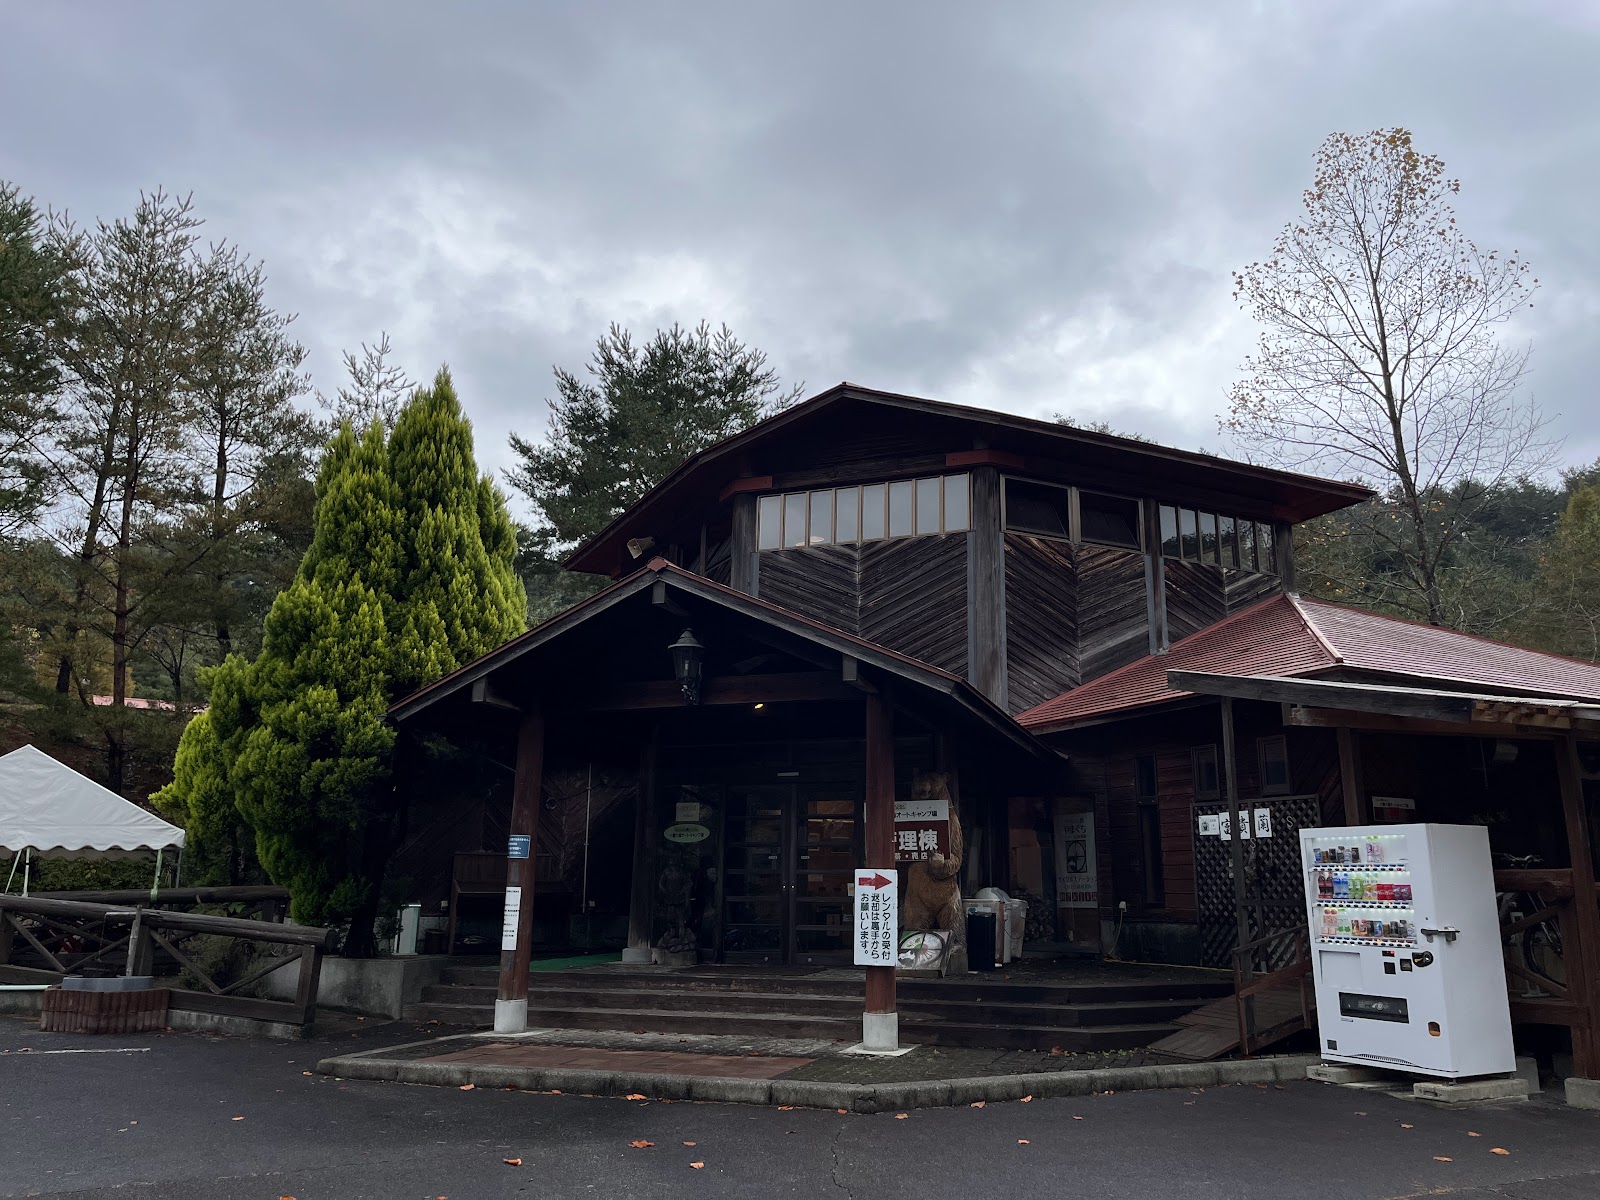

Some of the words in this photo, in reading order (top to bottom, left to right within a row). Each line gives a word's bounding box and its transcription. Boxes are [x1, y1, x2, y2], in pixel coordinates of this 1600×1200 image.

[892, 829, 939, 851] 理棟
[860, 893, 869, 954] お願いします。
[882, 893, 891, 960] レンタルの受付
